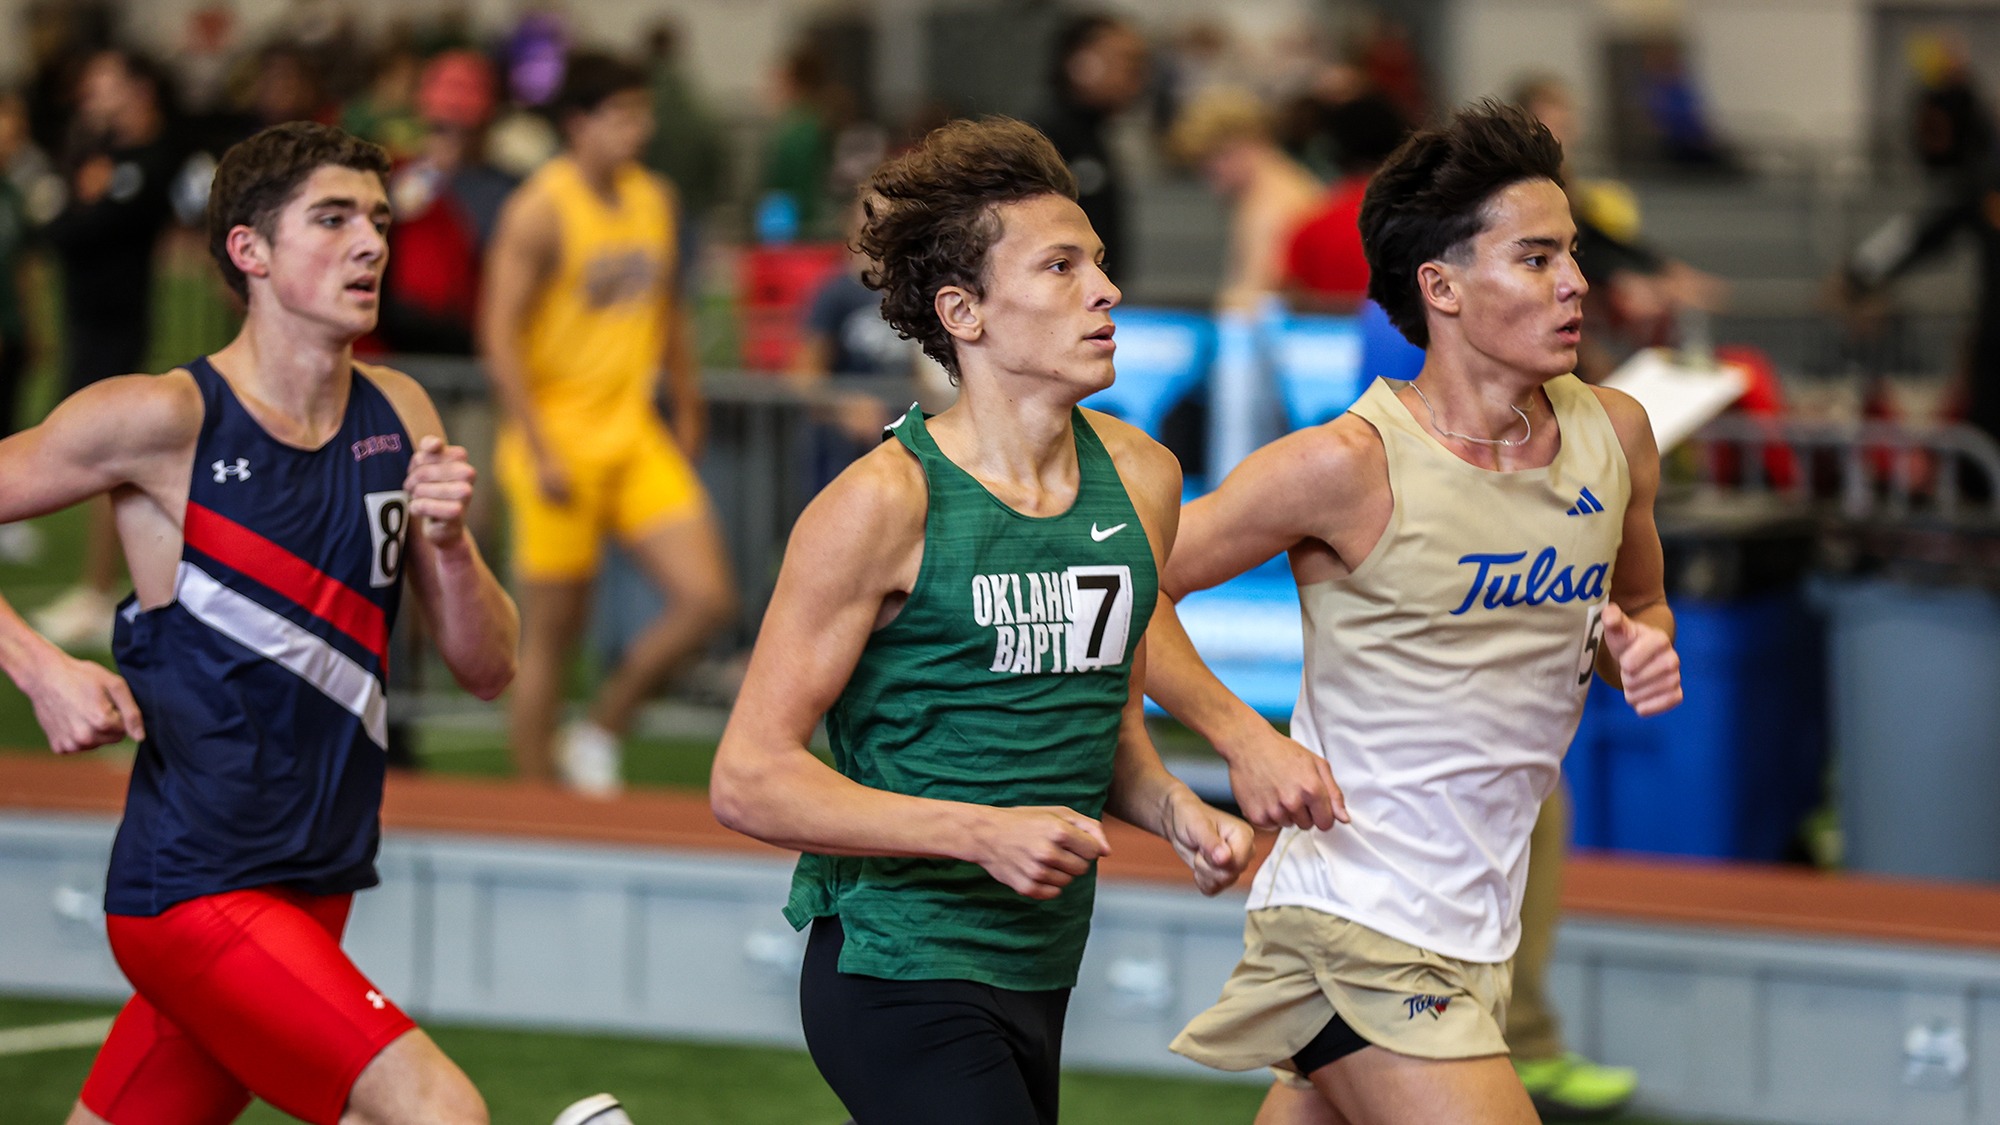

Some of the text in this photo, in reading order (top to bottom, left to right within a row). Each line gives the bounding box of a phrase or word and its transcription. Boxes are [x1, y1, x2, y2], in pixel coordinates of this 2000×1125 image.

[380, 501, 404, 578] 8
[972, 571, 1074, 627] OKLAHO
[1076, 575, 1121, 659] 7
[1449, 545, 1609, 616] Tulsa
[989, 623, 1103, 674] BAPTI
[1578, 611, 1602, 686] 5
